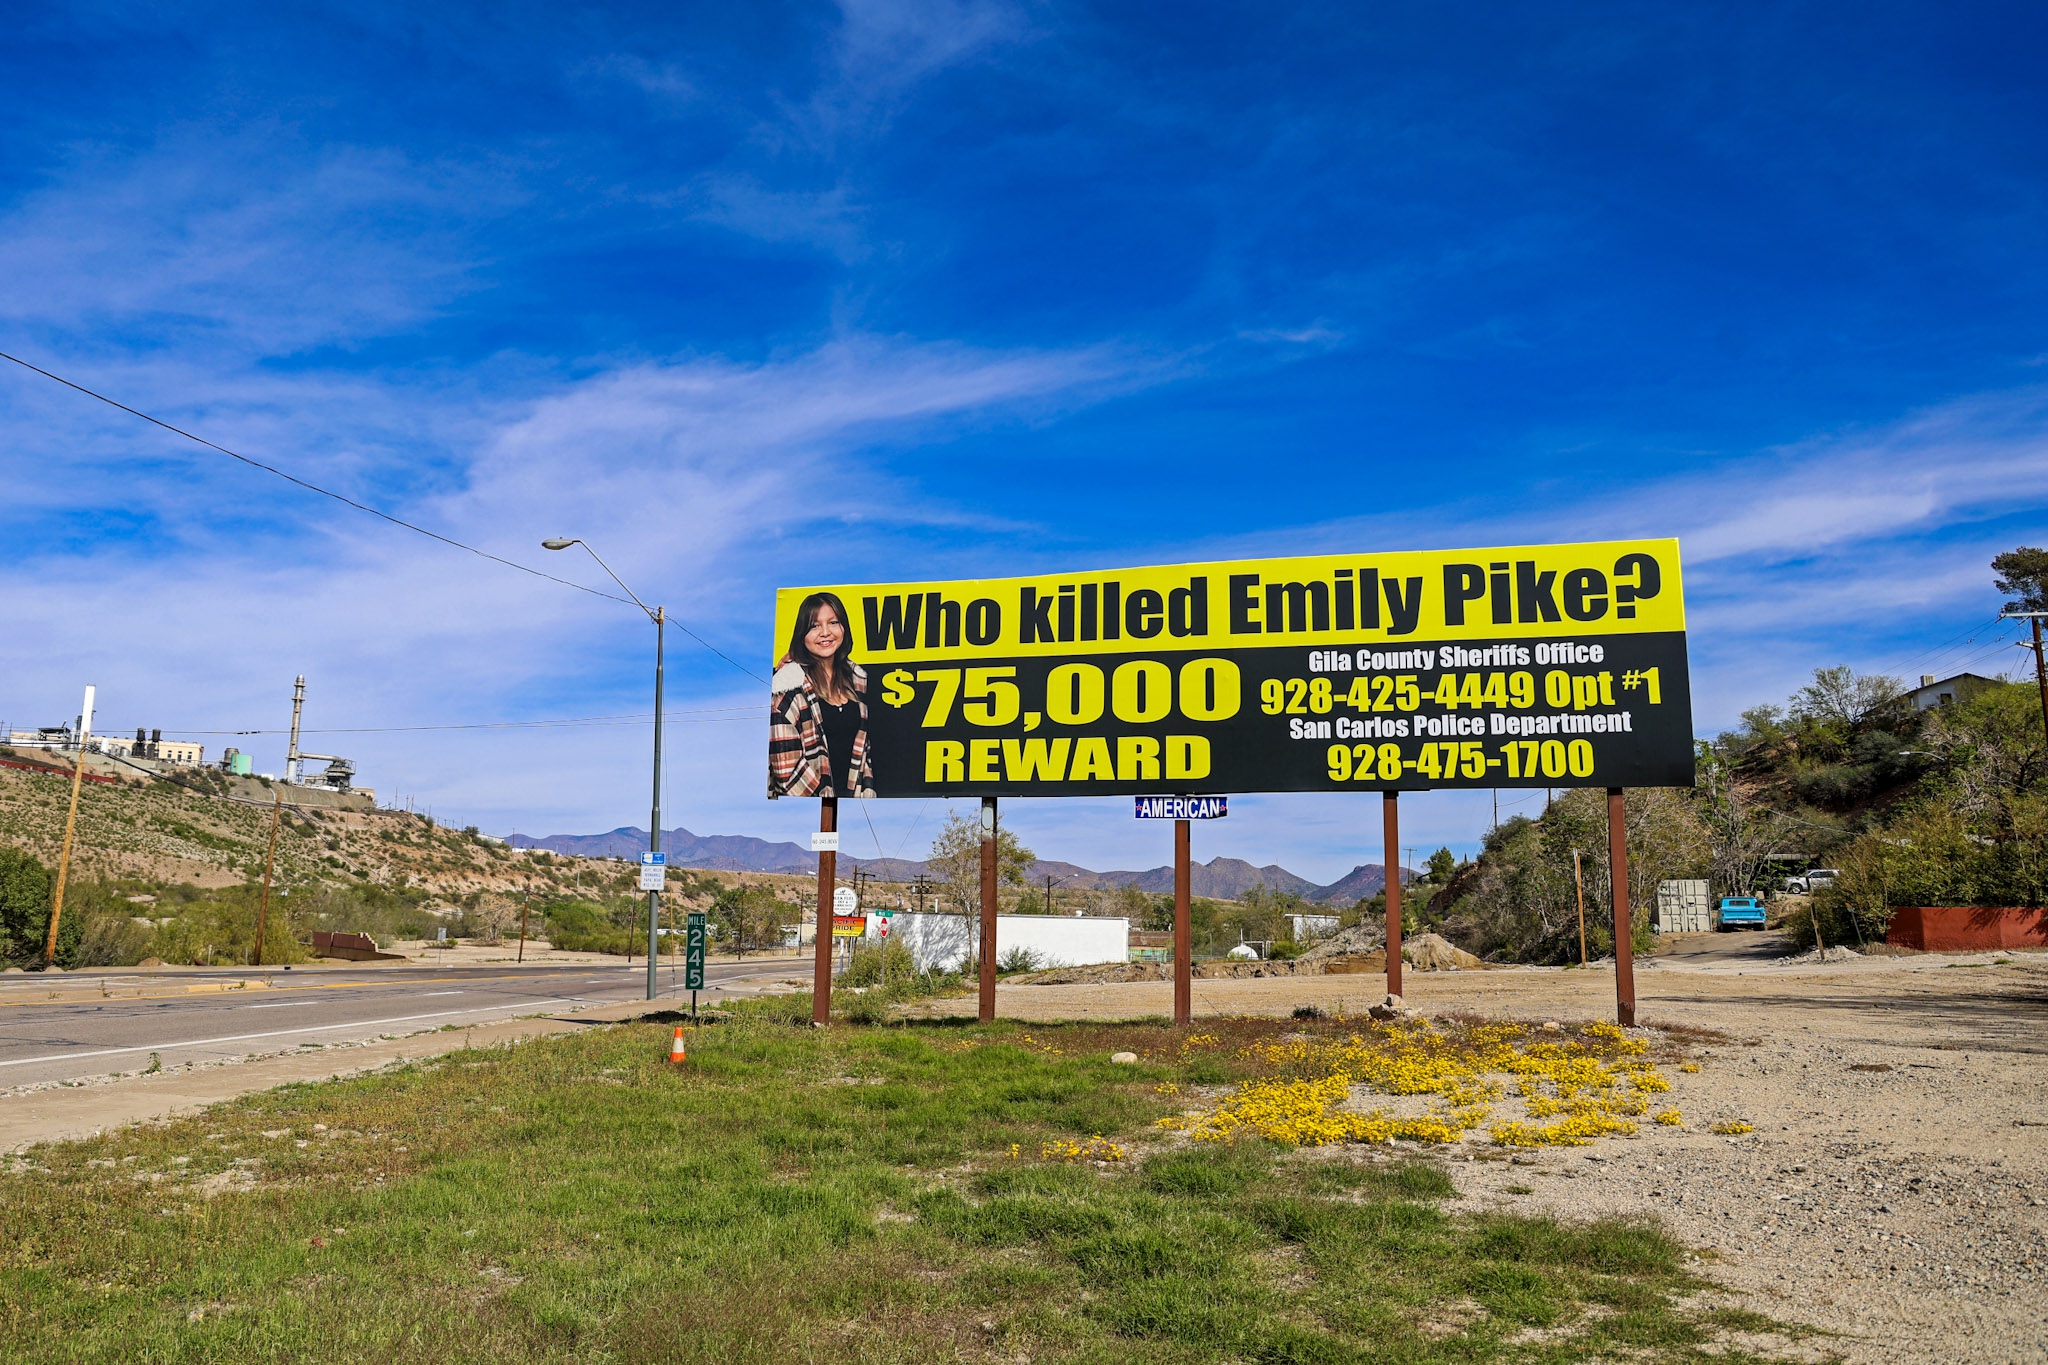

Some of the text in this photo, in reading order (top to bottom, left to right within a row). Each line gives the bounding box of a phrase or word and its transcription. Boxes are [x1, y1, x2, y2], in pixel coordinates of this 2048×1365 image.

[863, 553, 1661, 651] Who killed Emily Pike?
[1308, 641, 1604, 672] Gila County Sheriffs Office
[882, 658, 1241, 732] $75,000
[1260, 667, 1661, 715] 928-425-4449 Opt #1
[1290, 711, 1633, 739] San Carlos Police Department
[924, 735, 1211, 782] REWARD
[1327, 739, 1595, 782] 928-475-1700
[1140, 798, 1220, 818] AMERICAN
[688, 916, 705, 925] MILE
[688, 928, 702, 987] 245
